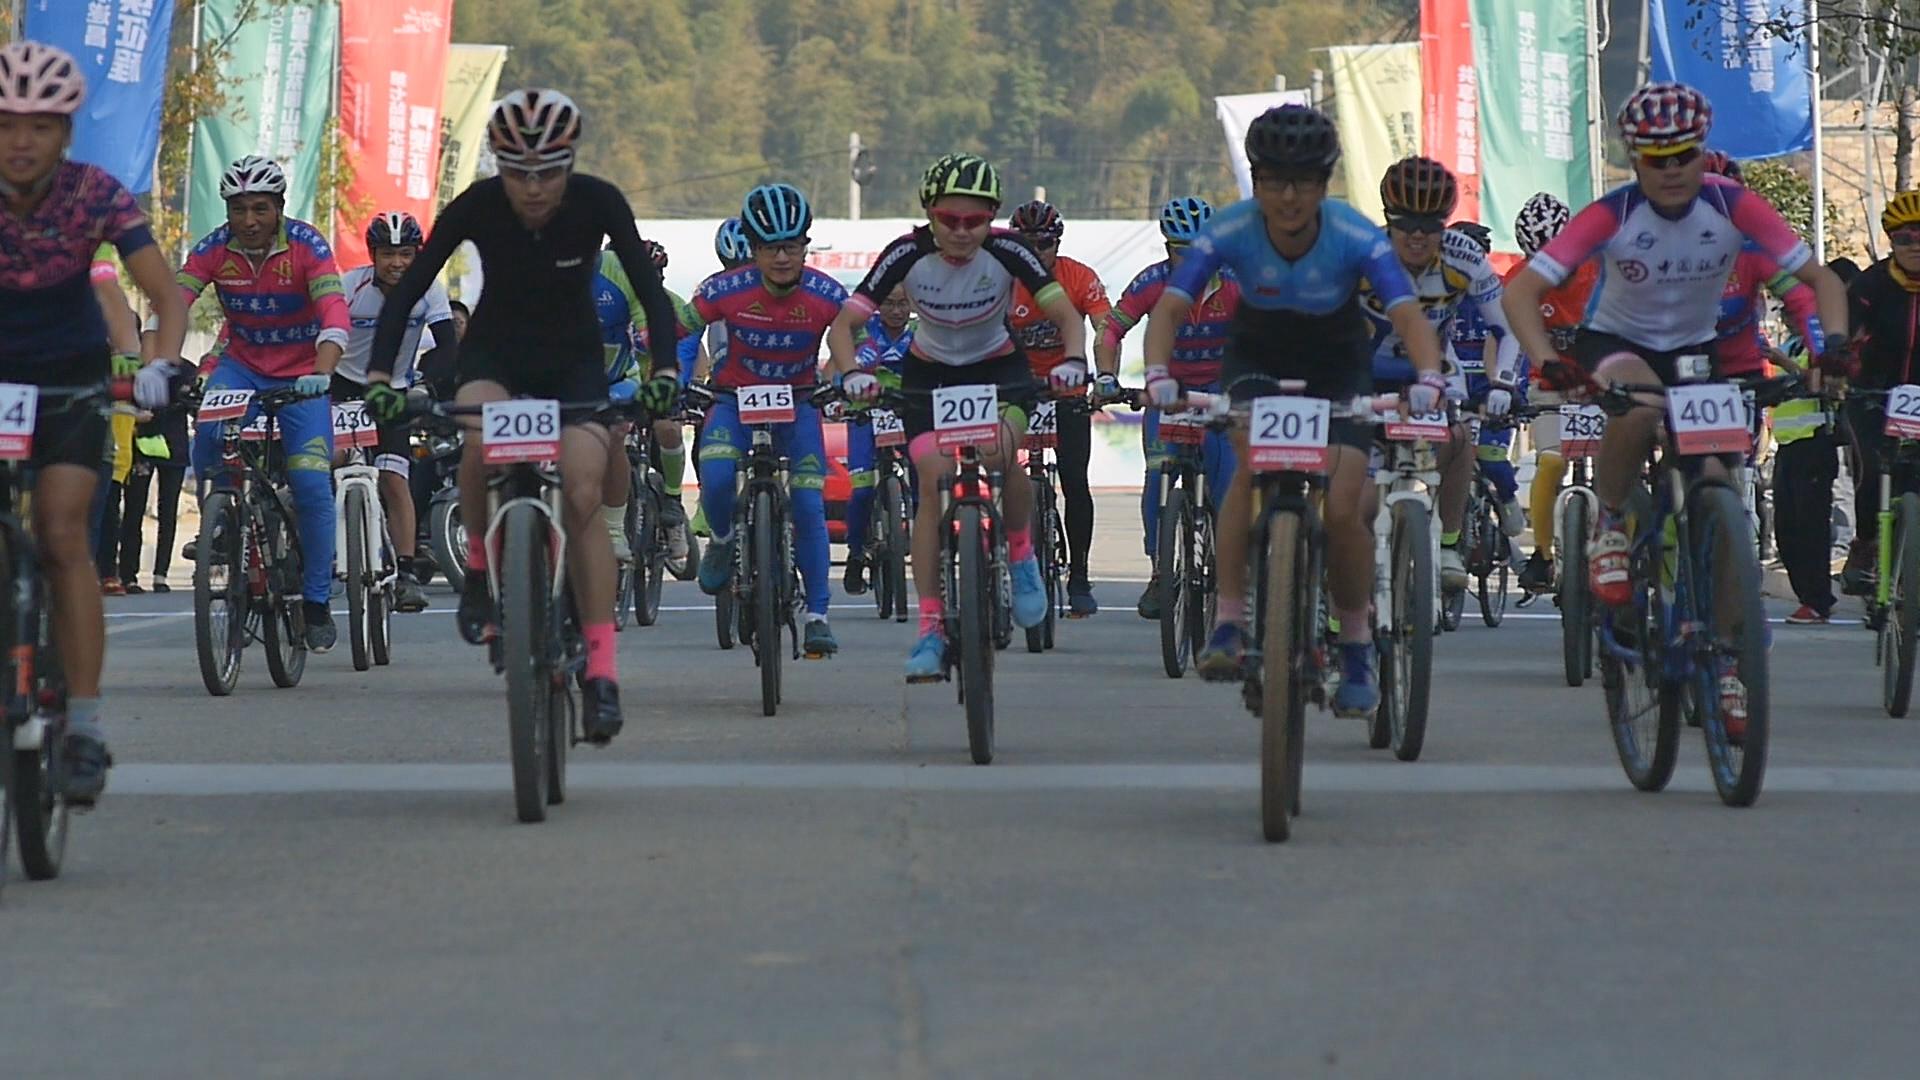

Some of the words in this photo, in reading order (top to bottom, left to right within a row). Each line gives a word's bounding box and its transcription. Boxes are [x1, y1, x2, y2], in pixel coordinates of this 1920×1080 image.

[918, 295, 997, 311] MERIDA
[206, 392, 249, 408] 409
[743, 391, 792, 408] 415
[940, 396, 994, 424] 207
[1680, 397, 1738, 425] 401
[335, 409, 373, 431] 430
[493, 412, 554, 437] 208
[1258, 412, 1321, 441] 201
